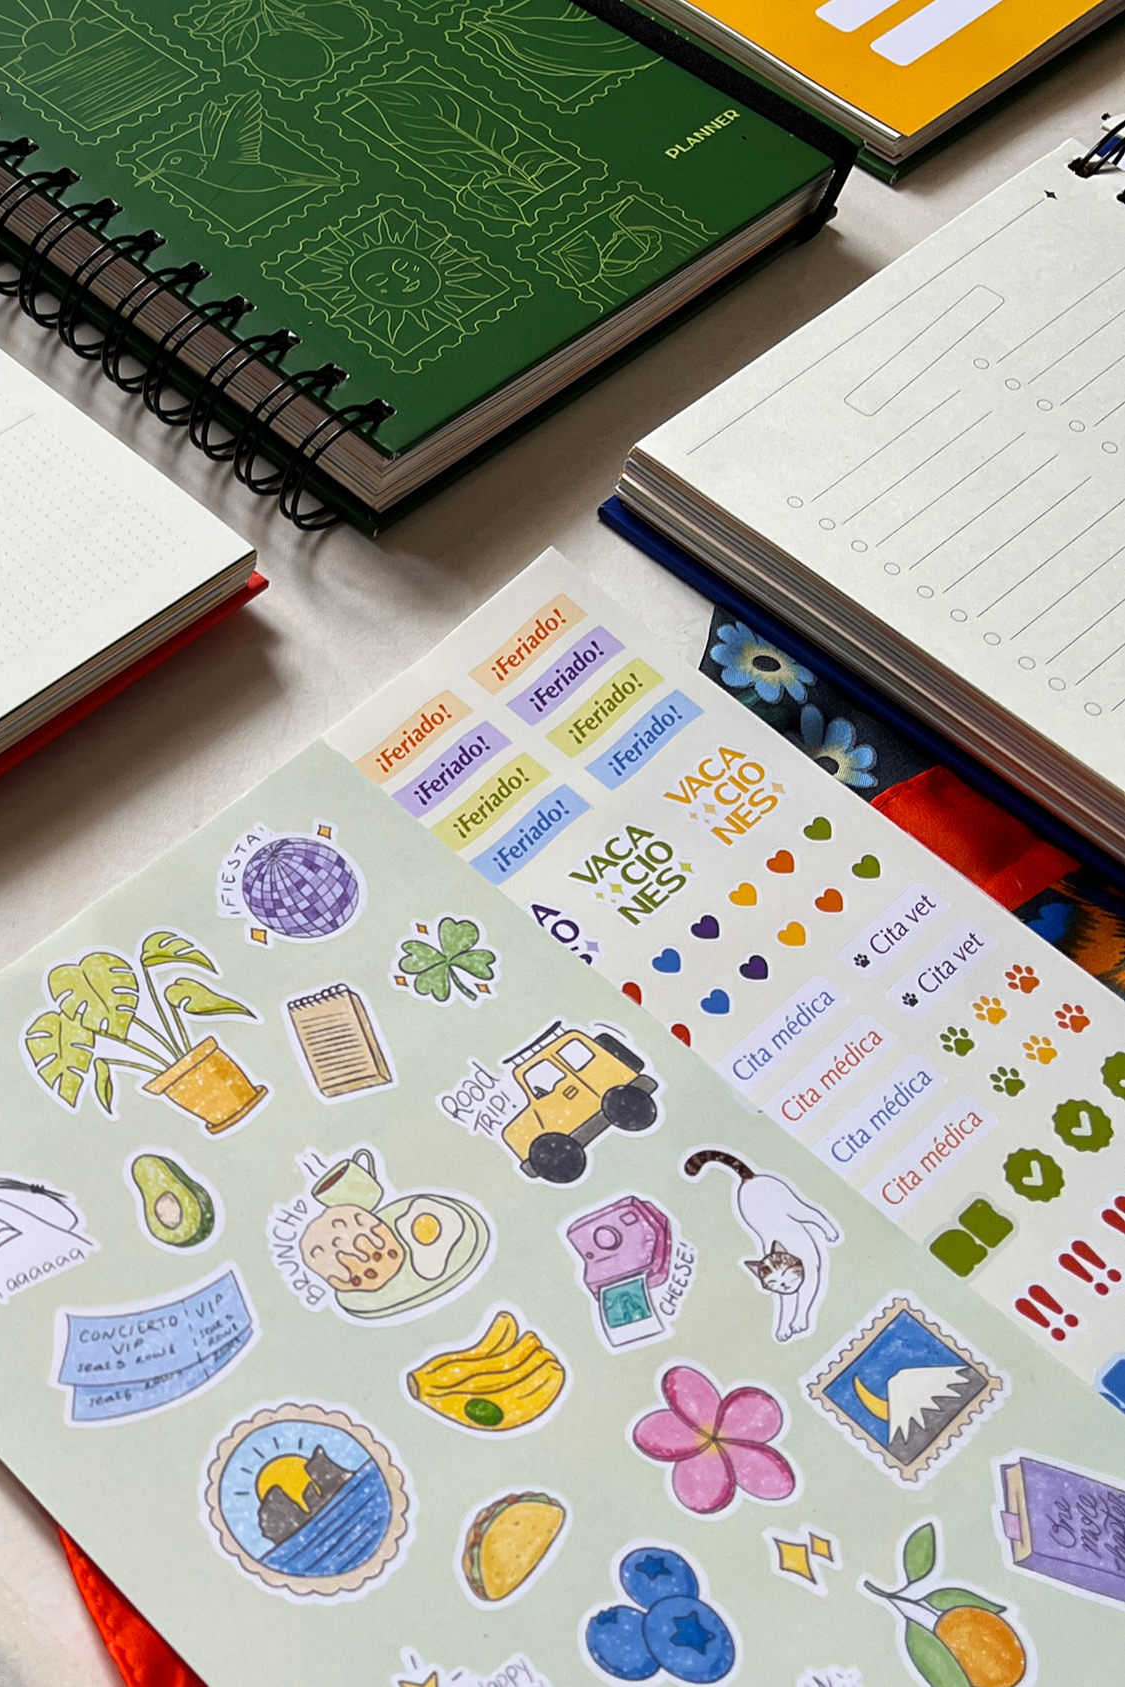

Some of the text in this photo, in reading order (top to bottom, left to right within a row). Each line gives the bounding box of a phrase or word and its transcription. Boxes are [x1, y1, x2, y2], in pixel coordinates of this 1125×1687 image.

[664, 109, 741, 160] PLANNER
[490, 608, 567, 682] ¡Feriado!
[528, 640, 605, 713] ¡Feriado!
[375, 703, 453, 774] ¡Feriado!
[567, 672, 644, 745] ¡Feriado!
[607, 704, 684, 777] ¡Feriado!
[413, 735, 491, 806] ¡Feriado!
[452, 766, 531, 839] ¡Feriado!
[662, 746, 747, 805] VACA
[713, 761, 766, 806] CIO
[492, 799, 571, 873] ¡Feriado!
[710, 787, 779, 846] NES
[568, 825, 655, 885] VACA
[620, 840, 674, 885] CIO
[617, 866, 687, 926] NES
[869, 894, 937, 954] Cita vet
[917, 932, 985, 993] Cita vet
[732, 991, 836, 1081] Cita médica
[781, 1030, 884, 1122] Cita médica
[473, 1090, 517, 1136] TRIP!
[831, 1070, 934, 1163] Cita médica
[881, 1111, 984, 1205] Cita médica
[272, 1208, 327, 1306] BRUNCH
[78, 1315, 179, 1345] CONCIERTO
[195, 1293, 224, 1318] VIP
[111, 1337, 145, 1355] VIP
